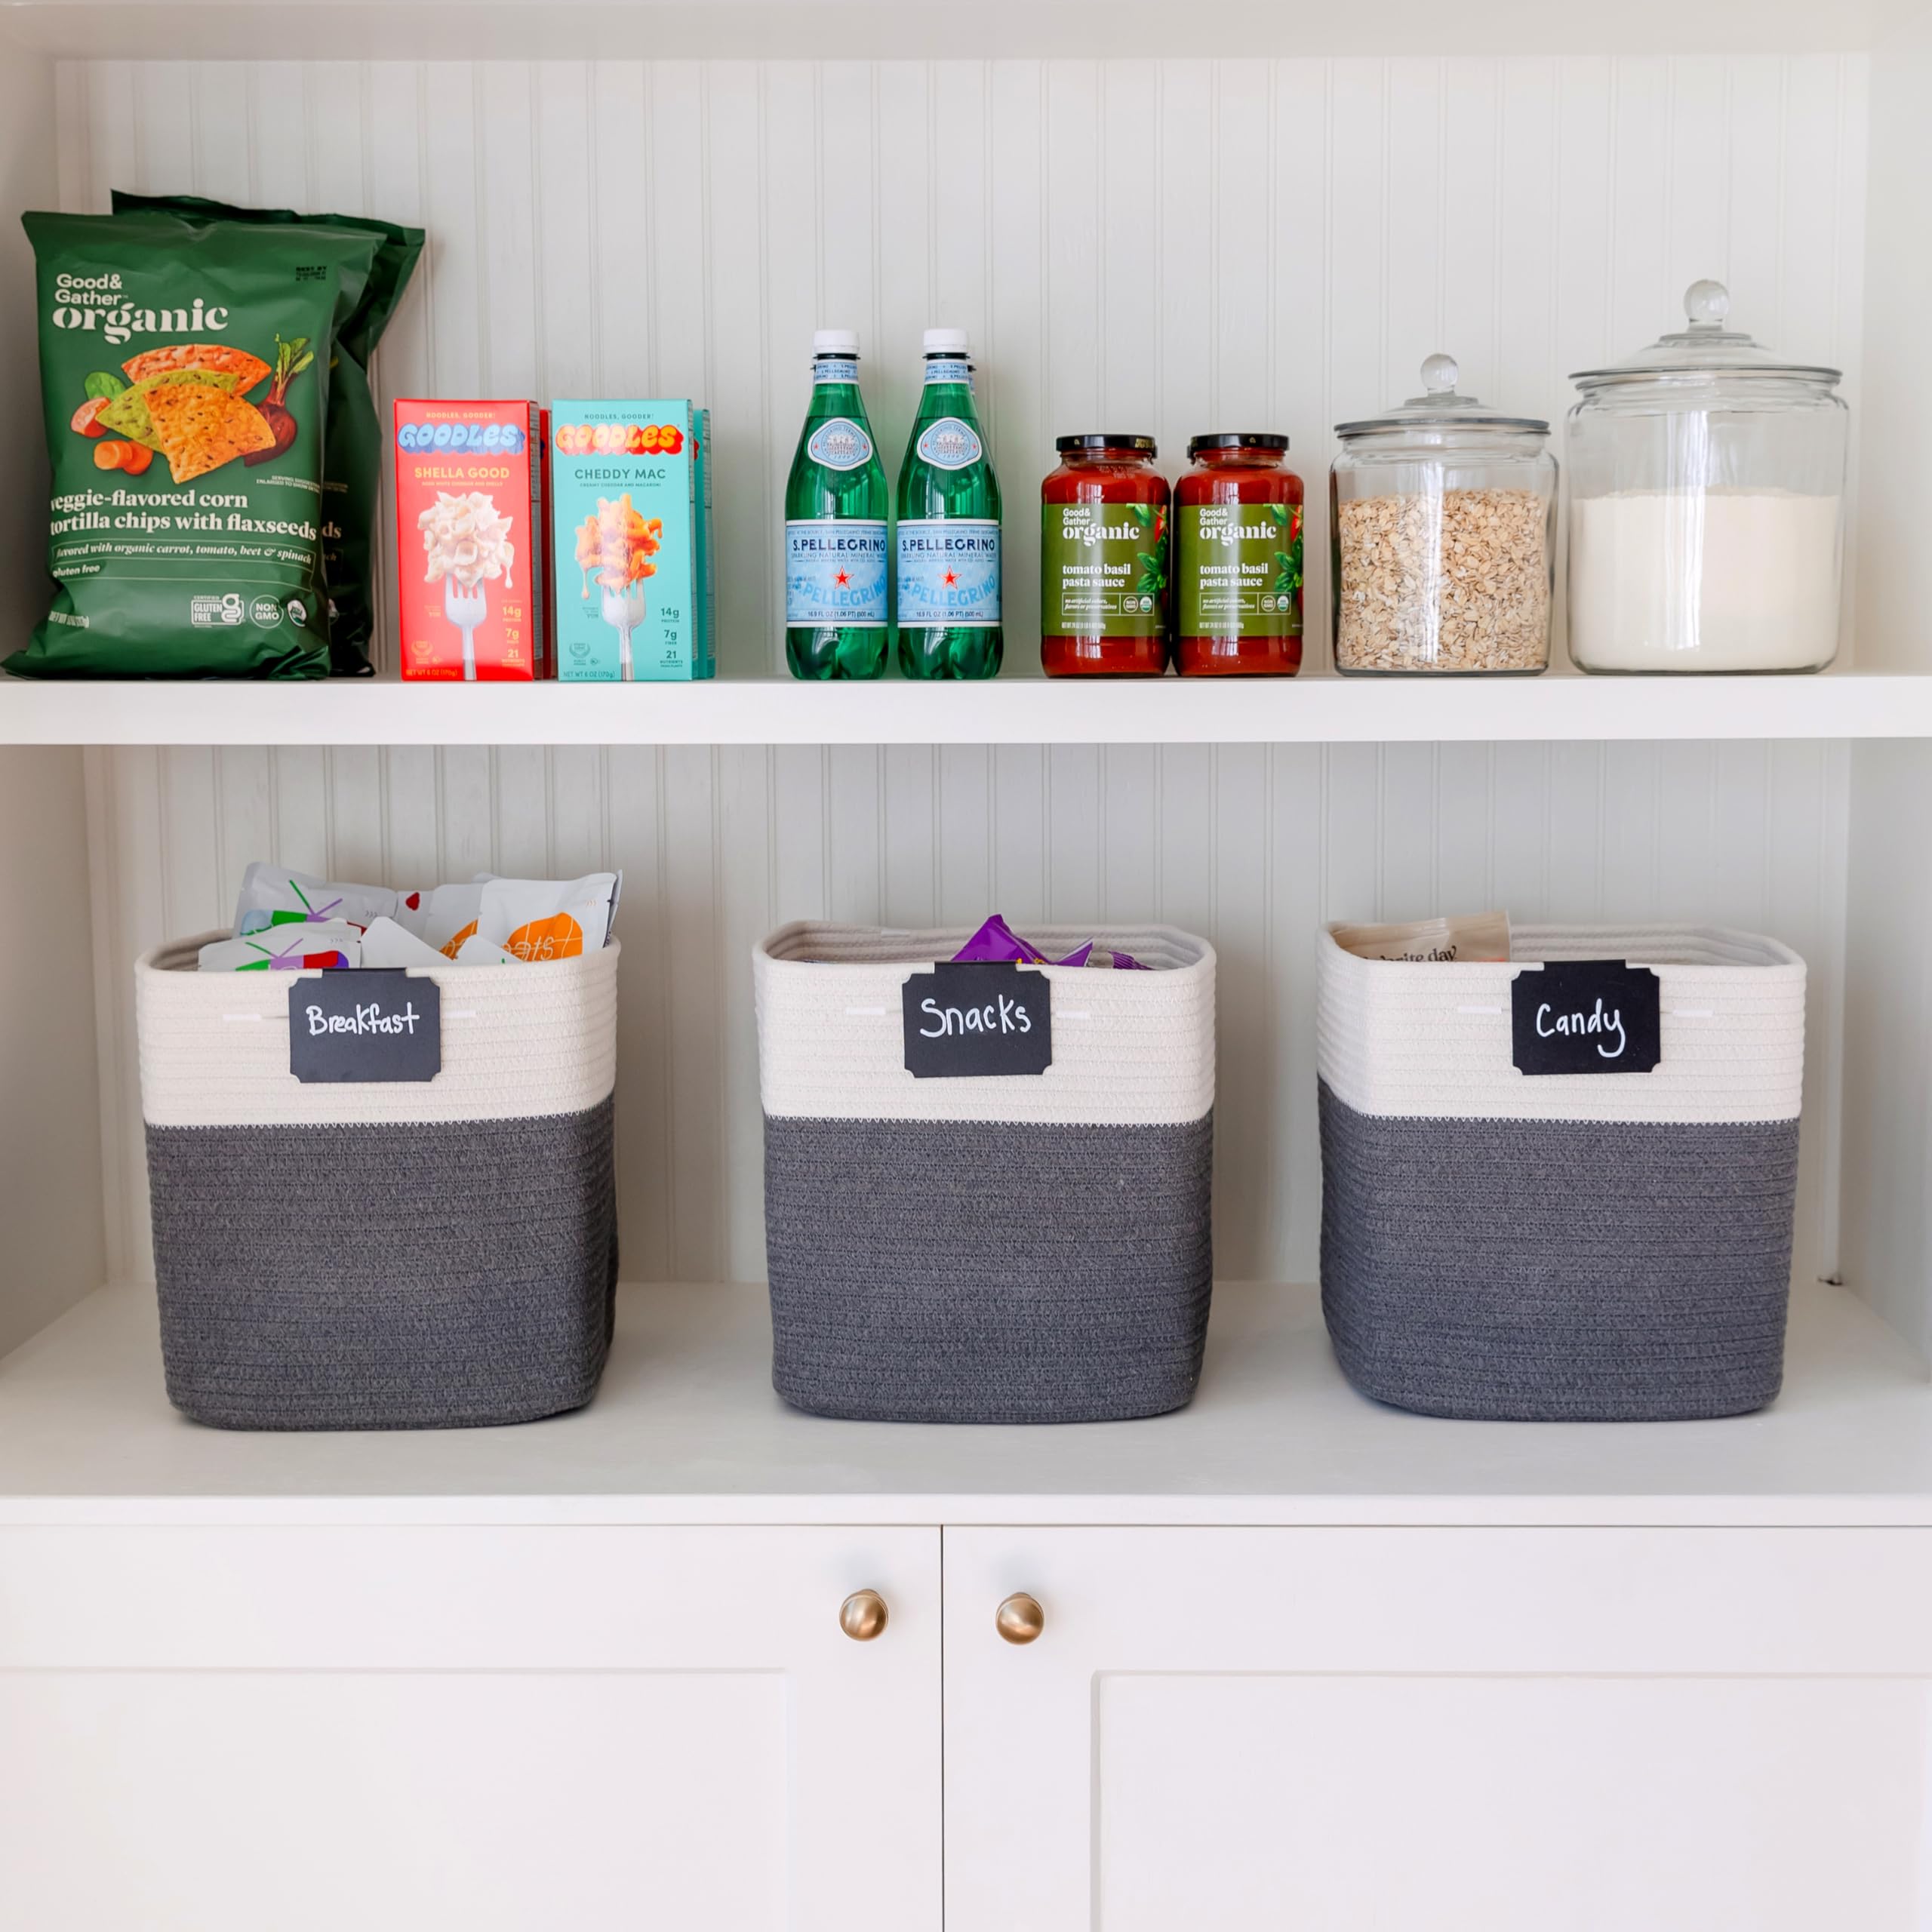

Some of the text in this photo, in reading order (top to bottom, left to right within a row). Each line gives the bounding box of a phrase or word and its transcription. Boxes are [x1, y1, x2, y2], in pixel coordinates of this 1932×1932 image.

[57, 273, 122, 290] Good&
[54, 289, 122, 306] Gather
[52, 298, 229, 345] organic
[398, 423, 522, 452] GOODLES
[555, 423, 681, 454] GOODLES
[415, 467, 509, 478] SHELLA GOOD
[574, 469, 666, 479] CHEDDY MAC
[199, 494, 248, 508] corn
[1063, 507, 1091, 517] Good&
[1199, 507, 1228, 517] Good&
[51, 512, 110, 535] tortilla
[115, 512, 171, 534] chips
[174, 512, 223, 531] with
[227, 513, 317, 540] flaxseeds
[1063, 517, 1091, 526] Gather
[1199, 517, 1227, 526] Gather
[1063, 521, 1140, 546] organic
[1200, 521, 1276, 546] organic
[792, 538, 886, 551] S.PELLEGRINO
[902, 538, 995, 552] S.PELLEGRINO
[91, 542, 112, 552] with
[114, 543, 155, 555] organic
[156, 544, 194, 555] carrot,
[196, 545, 238, 556] tomato,
[240, 546, 261, 555] beet
[277, 549, 312, 565] spinach
[82, 565, 100, 574] free
[1063, 563, 1131, 575] tomato basil
[1200, 562, 1269, 574] tomato basil
[1063, 577, 1125, 589] pasta sauce
[1200, 577, 1263, 589] pasta sauce
[194, 603, 223, 612] GLUTEN
[503, 606, 521, 617] 14g
[660, 608, 679, 618] 14g
[194, 613, 211, 622] FREE
[255, 612, 279, 620] GMO
[506, 628, 519, 639] 7g
[664, 629, 677, 641] 7g
[508, 649, 518, 657] 21
[306, 1002, 420, 1036] Breakfast
[920, 994, 1032, 1038] Snacks
[1537, 998, 1626, 1057] Candy
